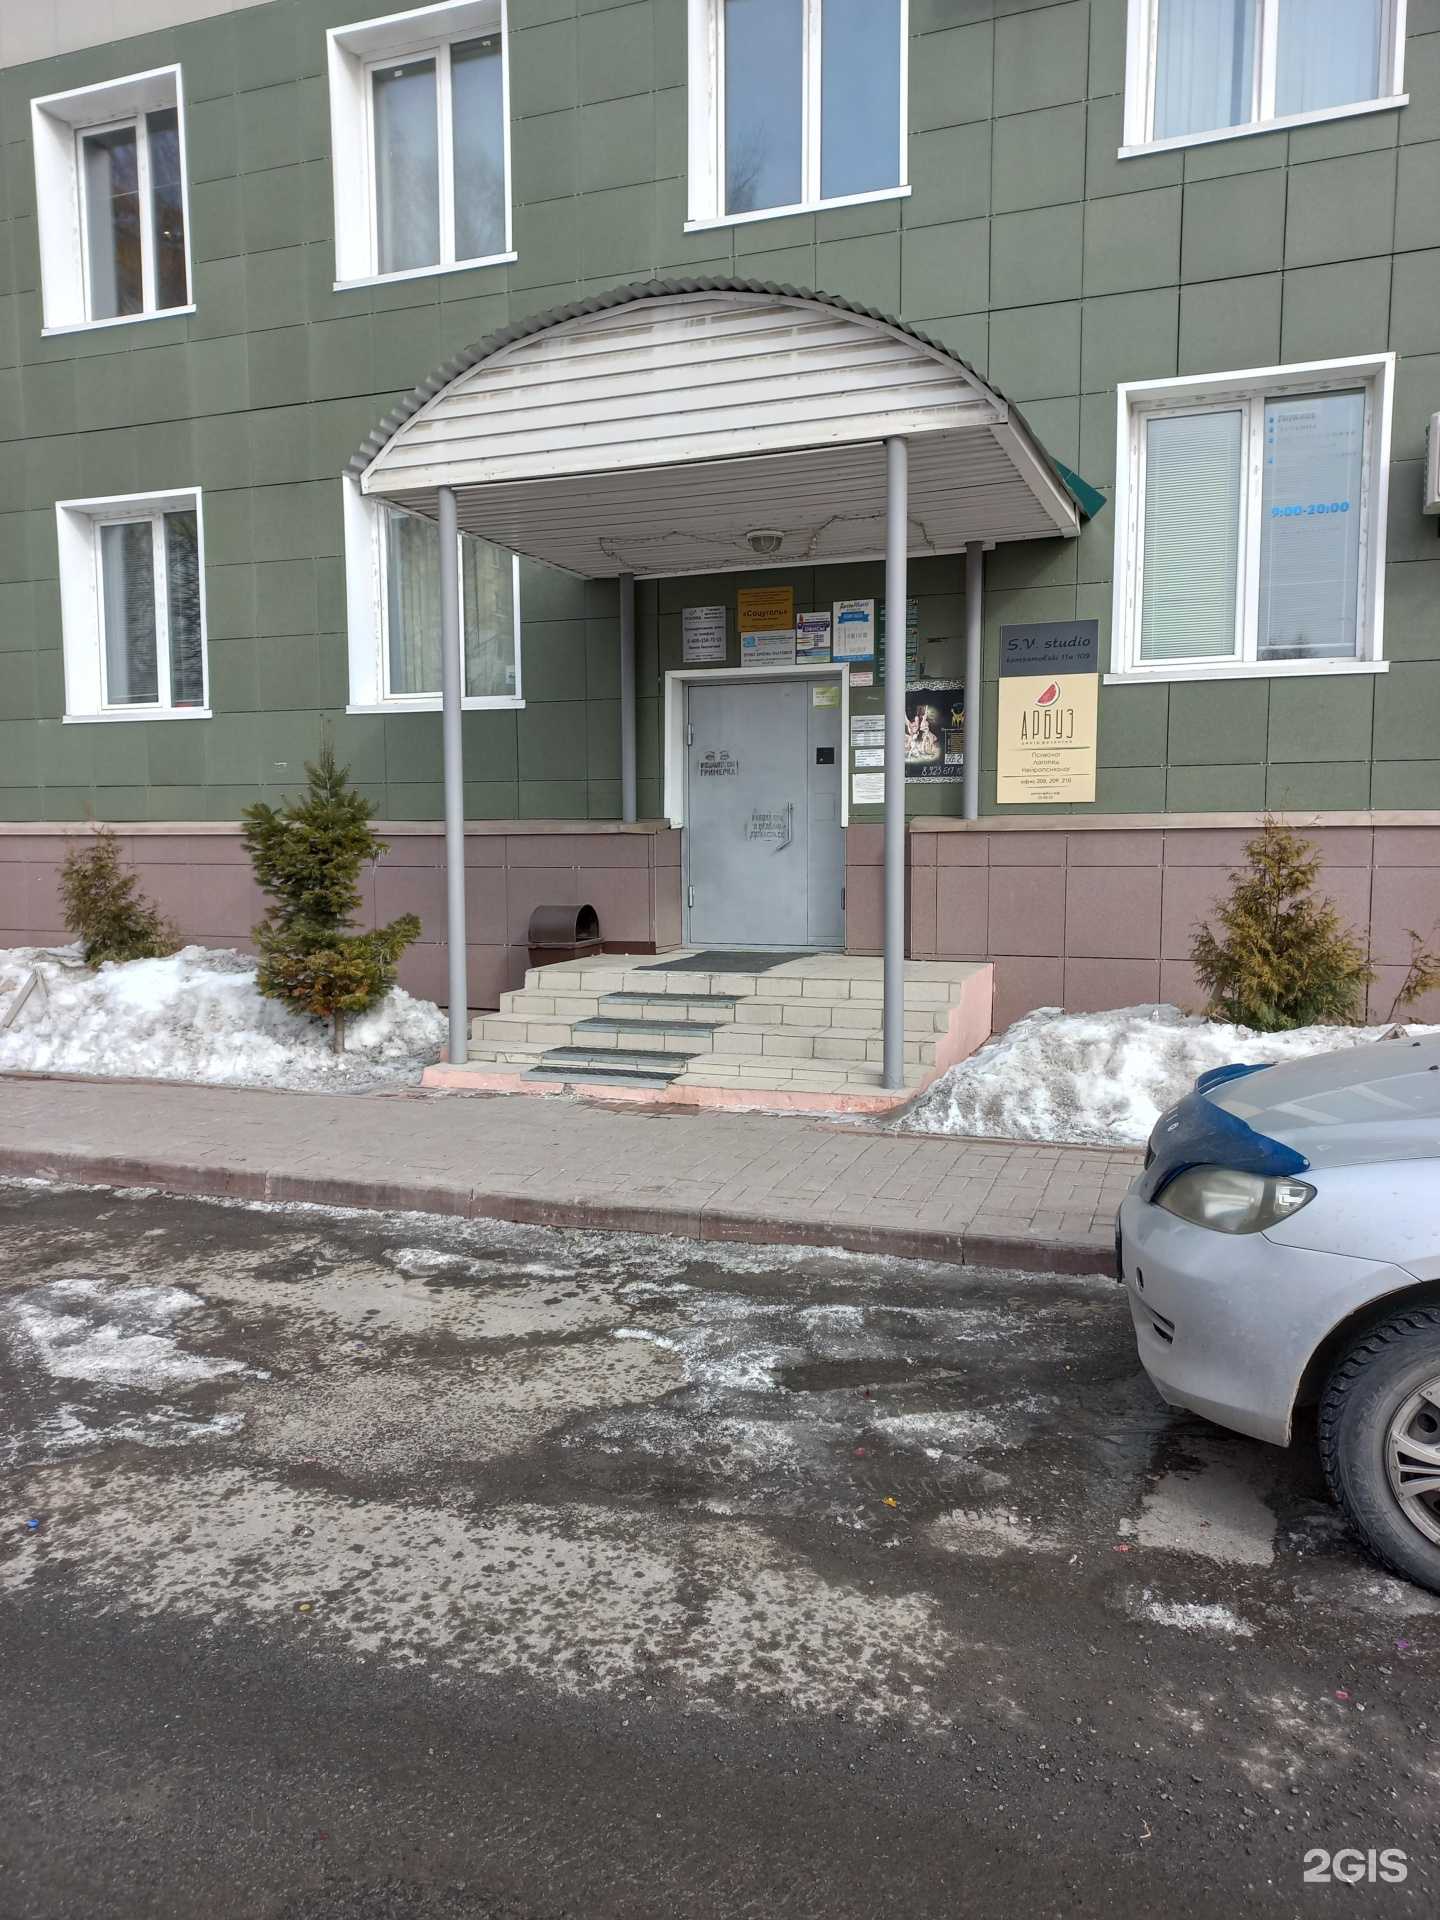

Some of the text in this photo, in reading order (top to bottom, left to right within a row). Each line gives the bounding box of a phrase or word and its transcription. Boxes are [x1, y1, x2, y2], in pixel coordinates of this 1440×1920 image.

[1271, 499, 1351, 518] 9:00-20:00
[1043, 635, 1091, 649] studio
[1021, 708, 1074, 741] АРБУЗ
